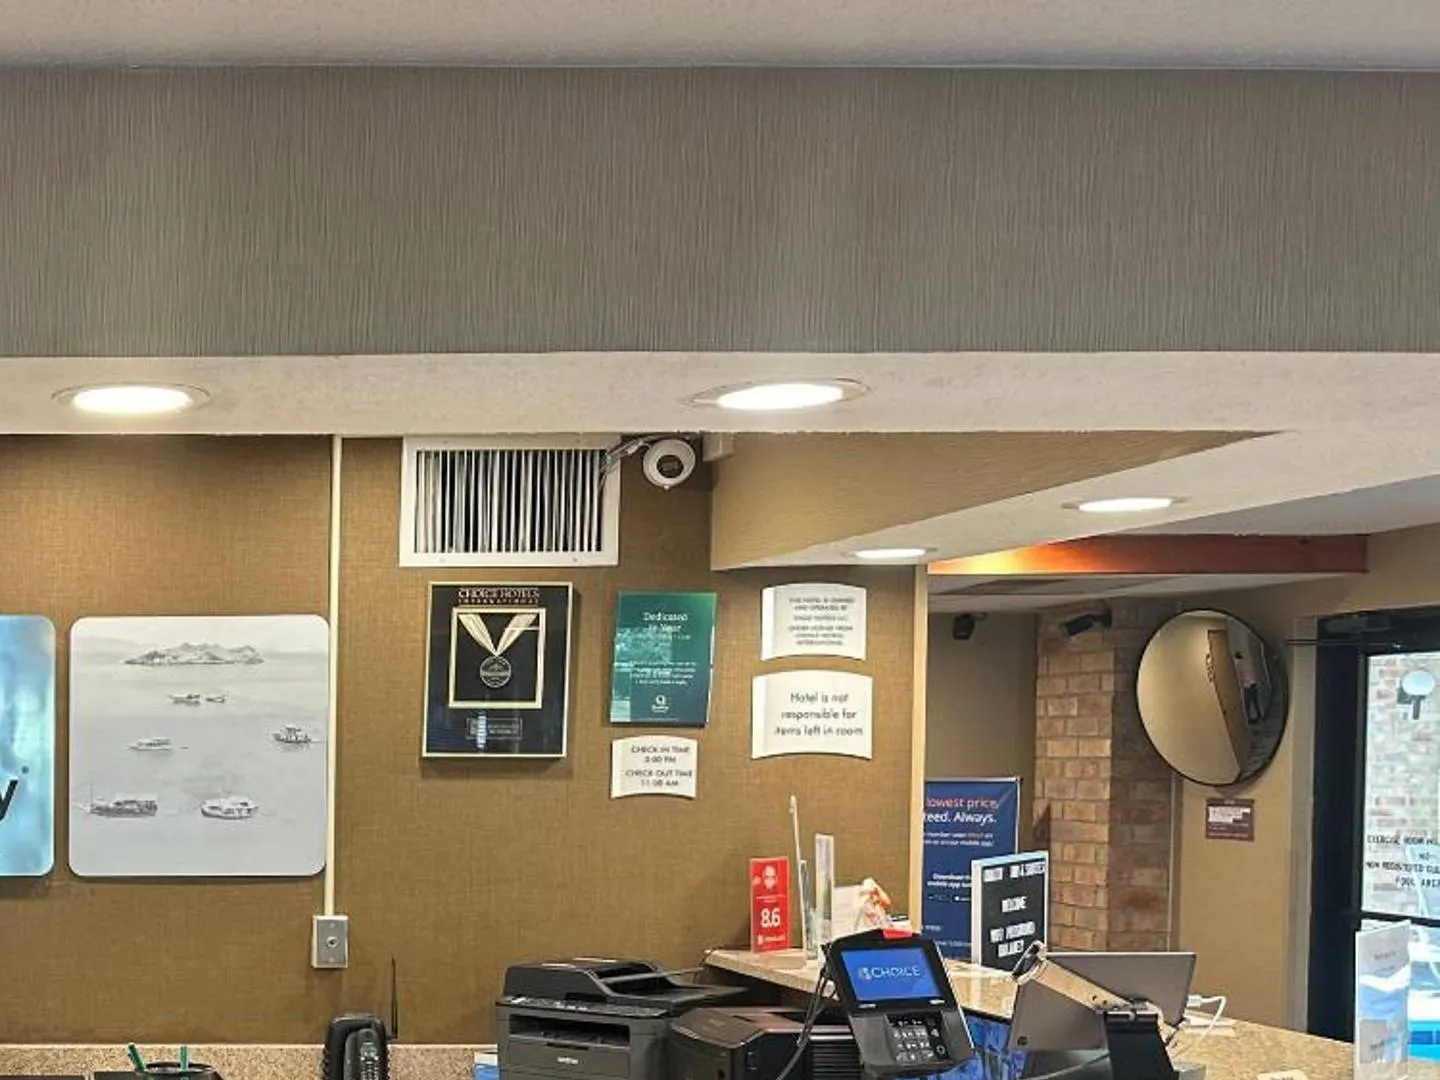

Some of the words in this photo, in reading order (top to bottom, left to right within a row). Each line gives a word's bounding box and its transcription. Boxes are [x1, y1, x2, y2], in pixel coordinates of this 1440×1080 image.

[500, 587, 540, 598] HOTELS
[790, 691, 819, 703] Hotel
[822, 691, 829, 703] is
[831, 693, 849, 703] not
[781, 707, 840, 720] responsible
[842, 707, 858, 719] for
[804, 724, 821, 736] left
[823, 724, 834, 736] in
[836, 727, 863, 736] room
[631, 745, 657, 753] CHECK
[664, 755, 676, 763] PM
[625, 769, 653, 777] CHECK
[656, 769, 673, 777] OUT
[675, 769, 693, 777] TIME
[927, 797, 964, 808] lowest
[954, 811, 997, 827] Always.
[1366, 834, 1401, 845] EXERCISE
[1404, 836, 1424, 846] ROOM
[760, 907, 781, 929] 8.6
[871, 964, 921, 978] CHOICE
